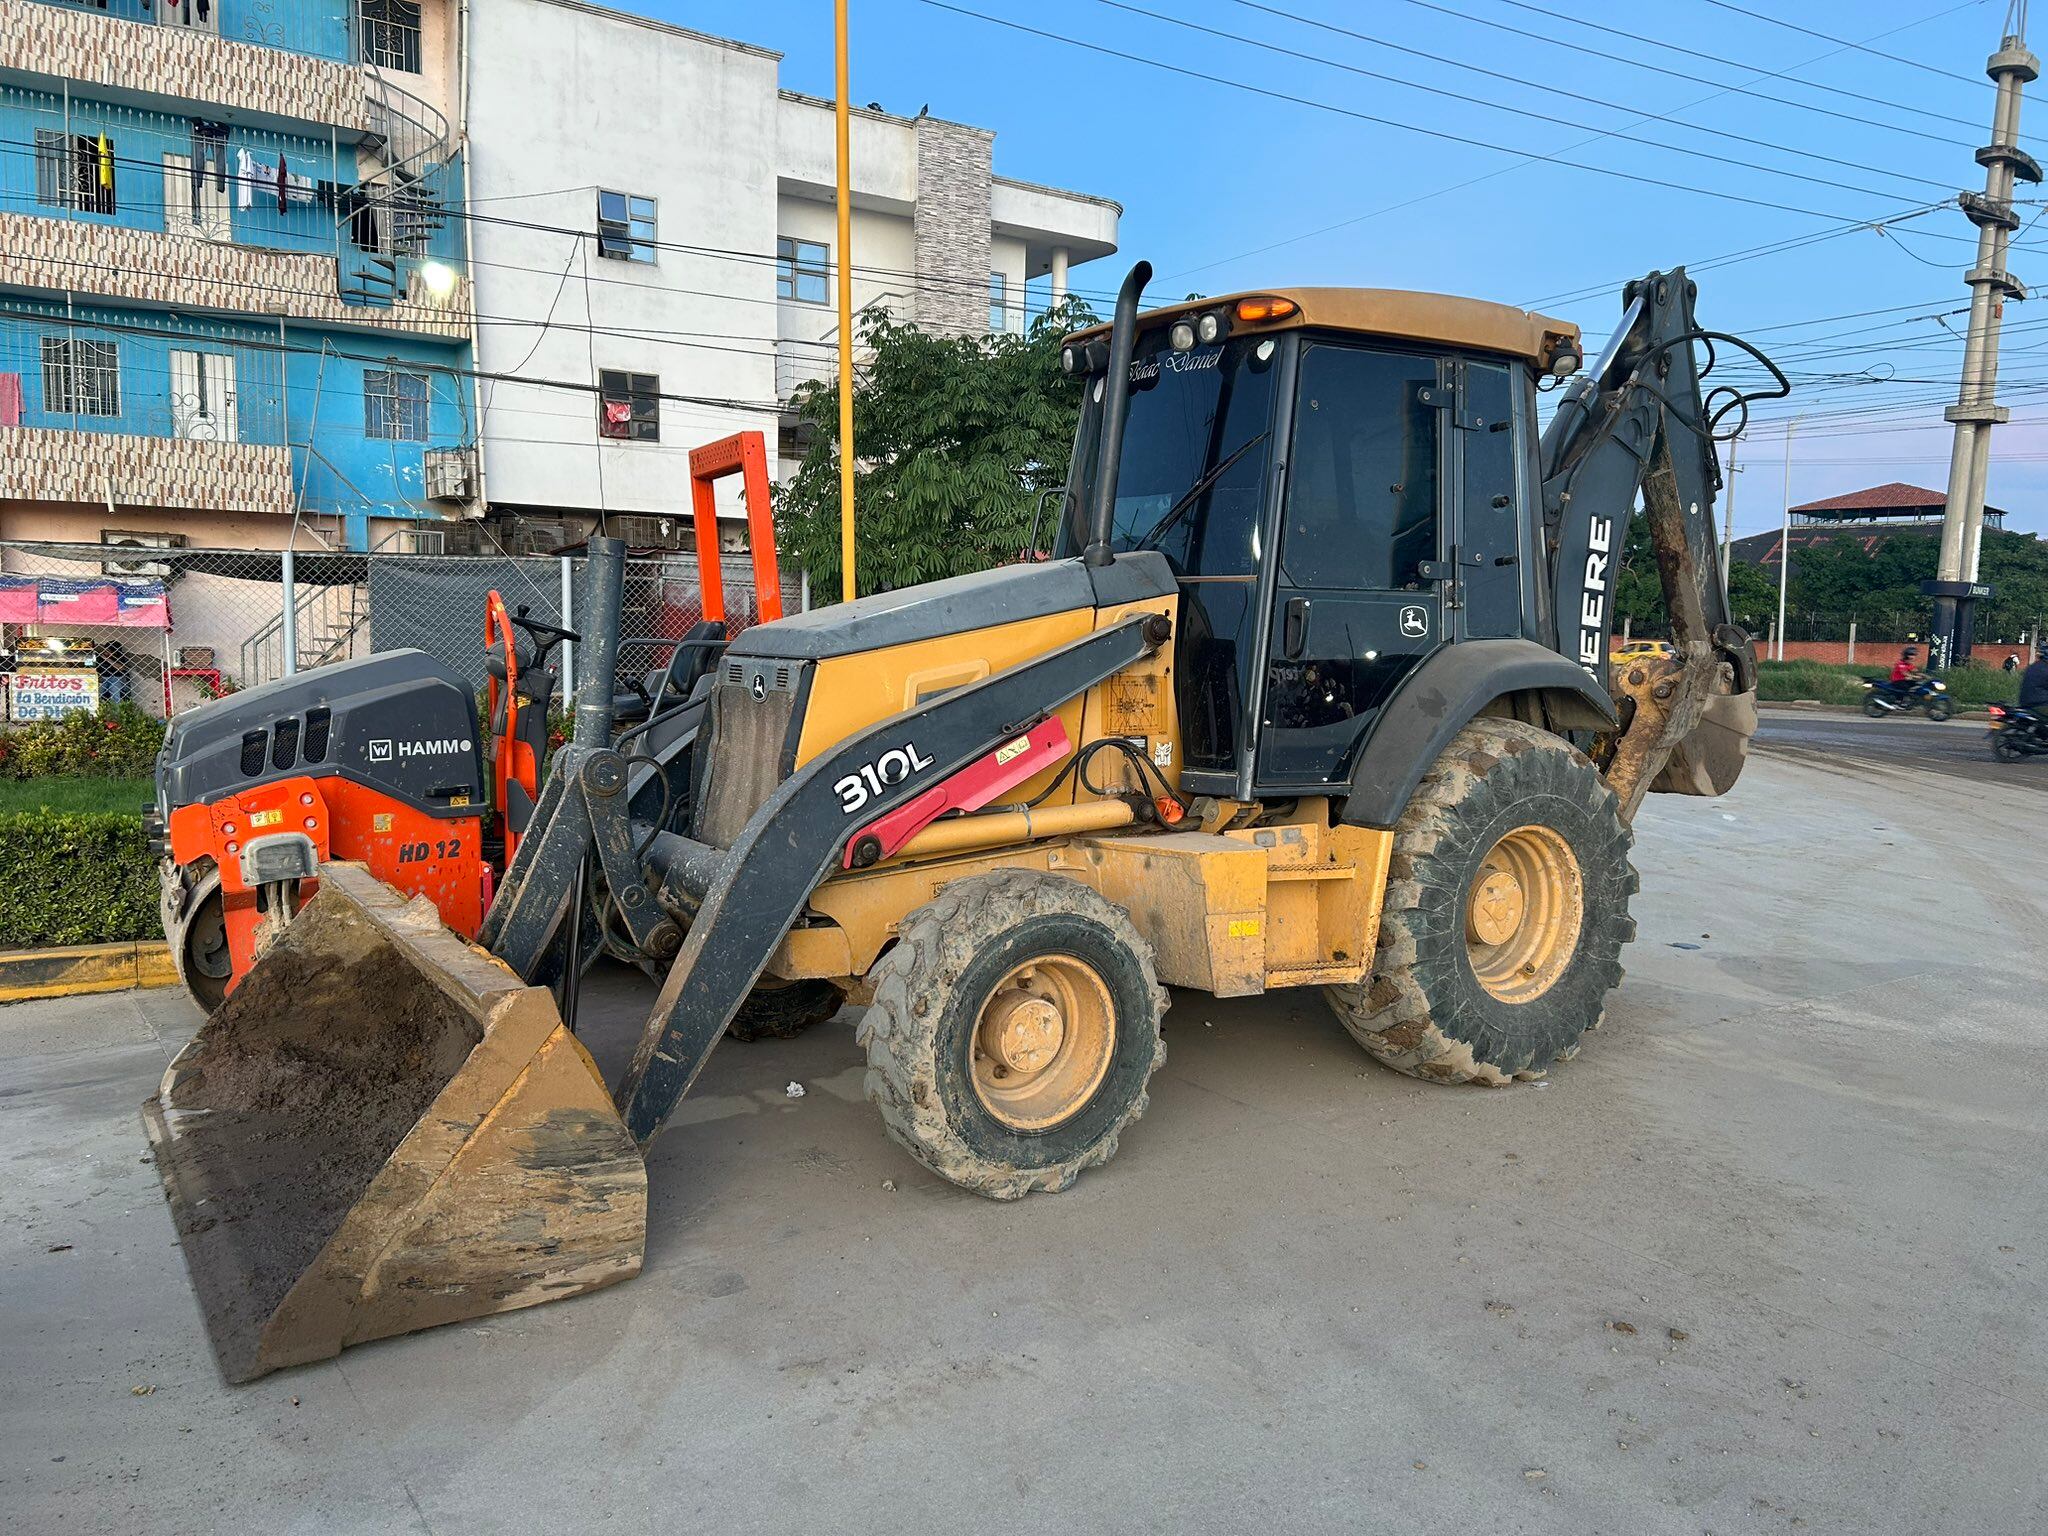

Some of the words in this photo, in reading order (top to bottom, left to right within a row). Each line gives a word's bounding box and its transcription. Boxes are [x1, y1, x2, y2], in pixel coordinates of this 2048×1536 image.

[1165, 345, 1225, 373] Daniel
[15, 674, 82, 691] Fritos
[833, 742, 935, 814] 310L
[399, 842, 430, 863] HD
[436, 839, 461, 859] 12
